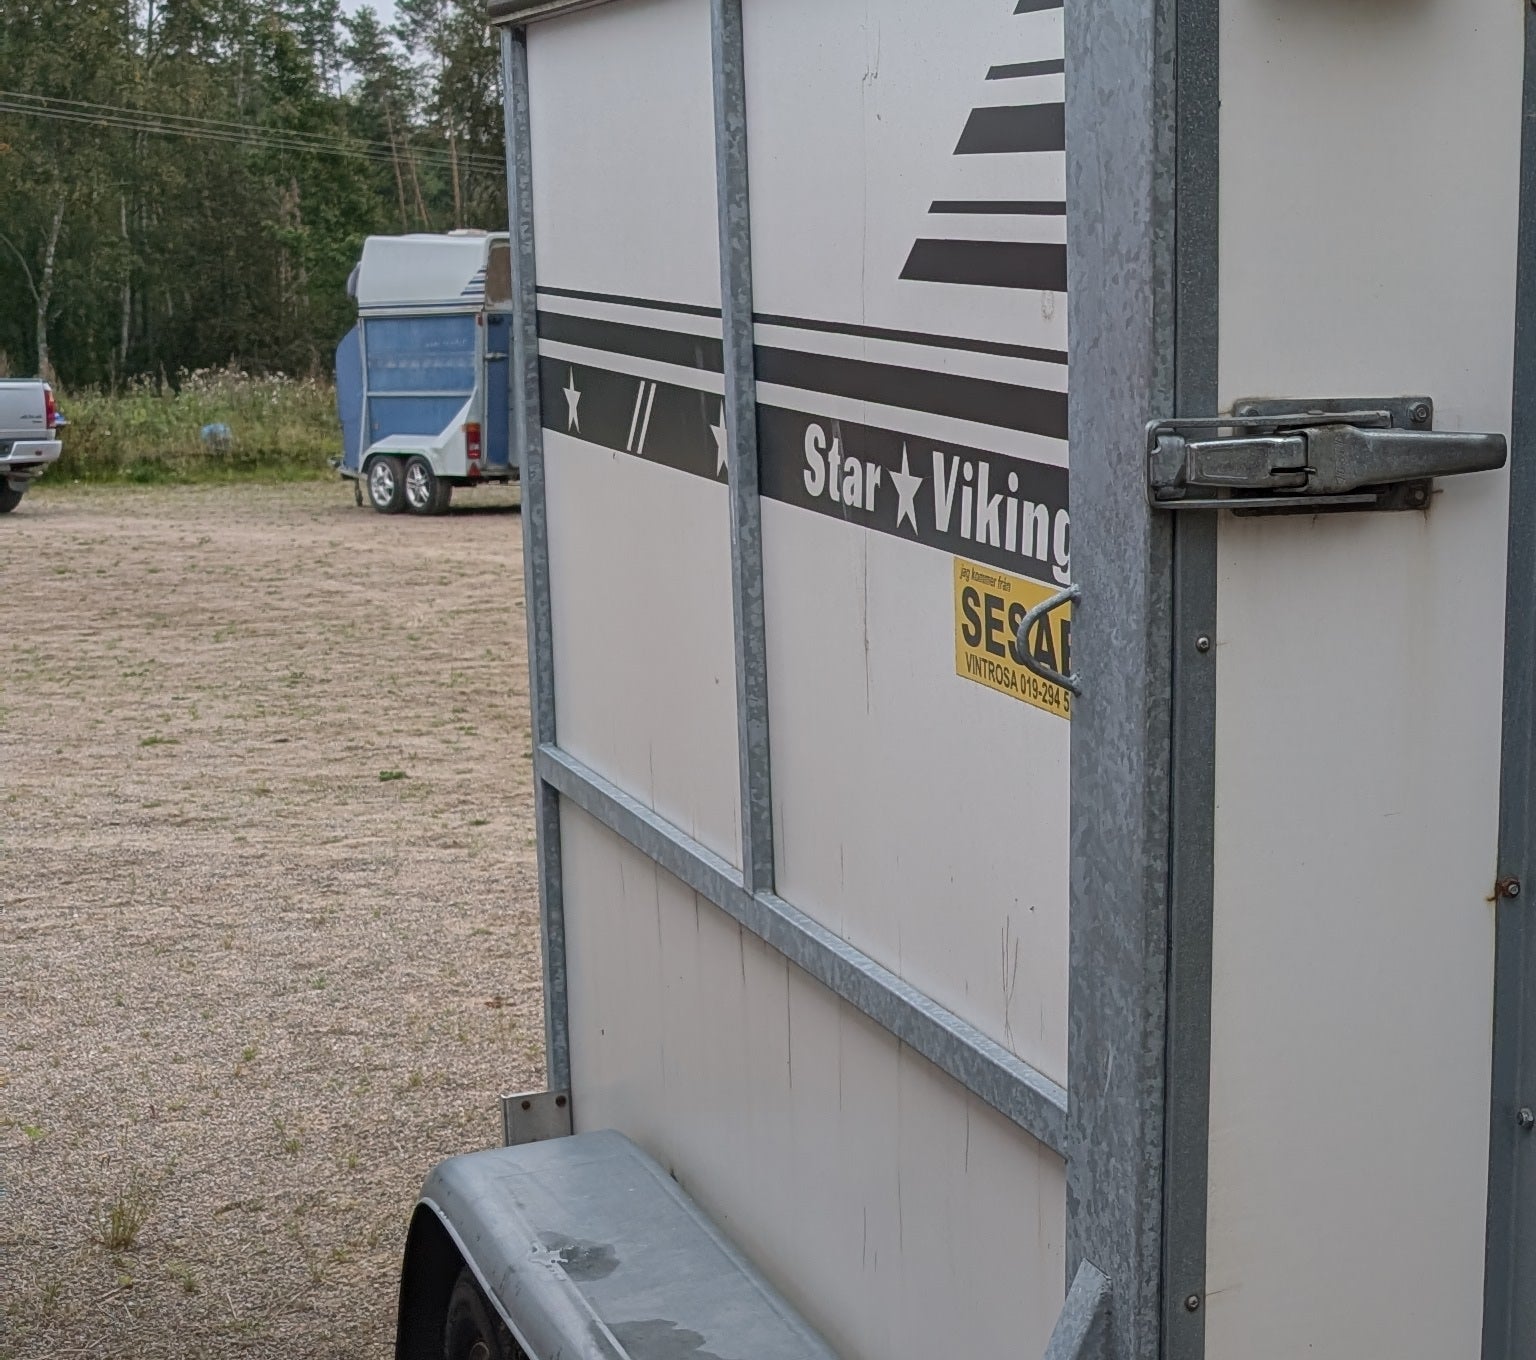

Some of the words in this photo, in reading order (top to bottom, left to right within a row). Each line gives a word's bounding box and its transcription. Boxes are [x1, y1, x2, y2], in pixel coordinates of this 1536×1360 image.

[803, 423, 882, 512] Star
[932, 450, 1071, 586] Viking
[965, 651, 1018, 692] VINTROSA
[1020, 673, 1061, 709] 019-294
